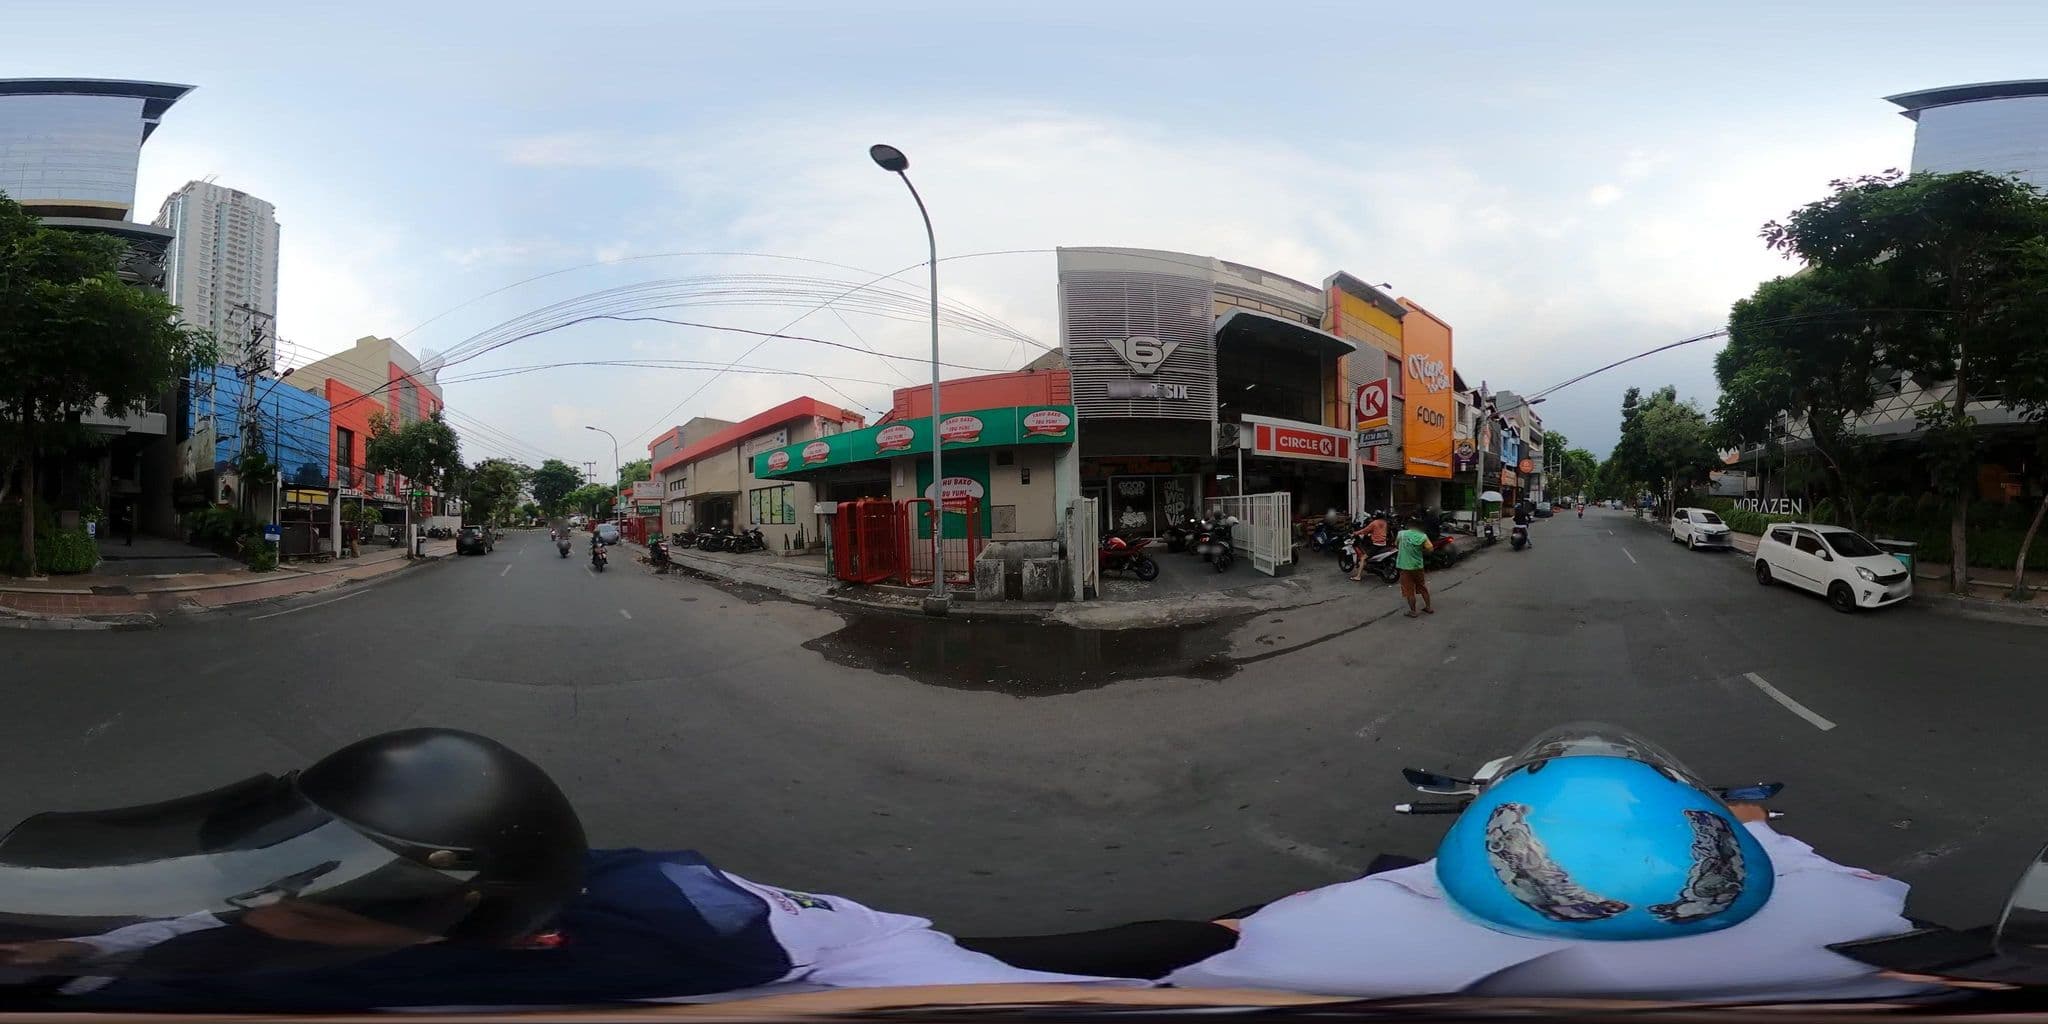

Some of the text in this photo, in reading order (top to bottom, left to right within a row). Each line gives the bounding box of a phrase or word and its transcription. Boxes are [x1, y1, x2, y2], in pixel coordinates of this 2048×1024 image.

[1164, 383, 1188, 399] SIX
[1362, 388, 1382, 413] K
[1417, 406, 1445, 430] FOOM
[1280, 436, 1332, 453] CIRCLE K
[1733, 497, 1802, 515] MORAZEN
